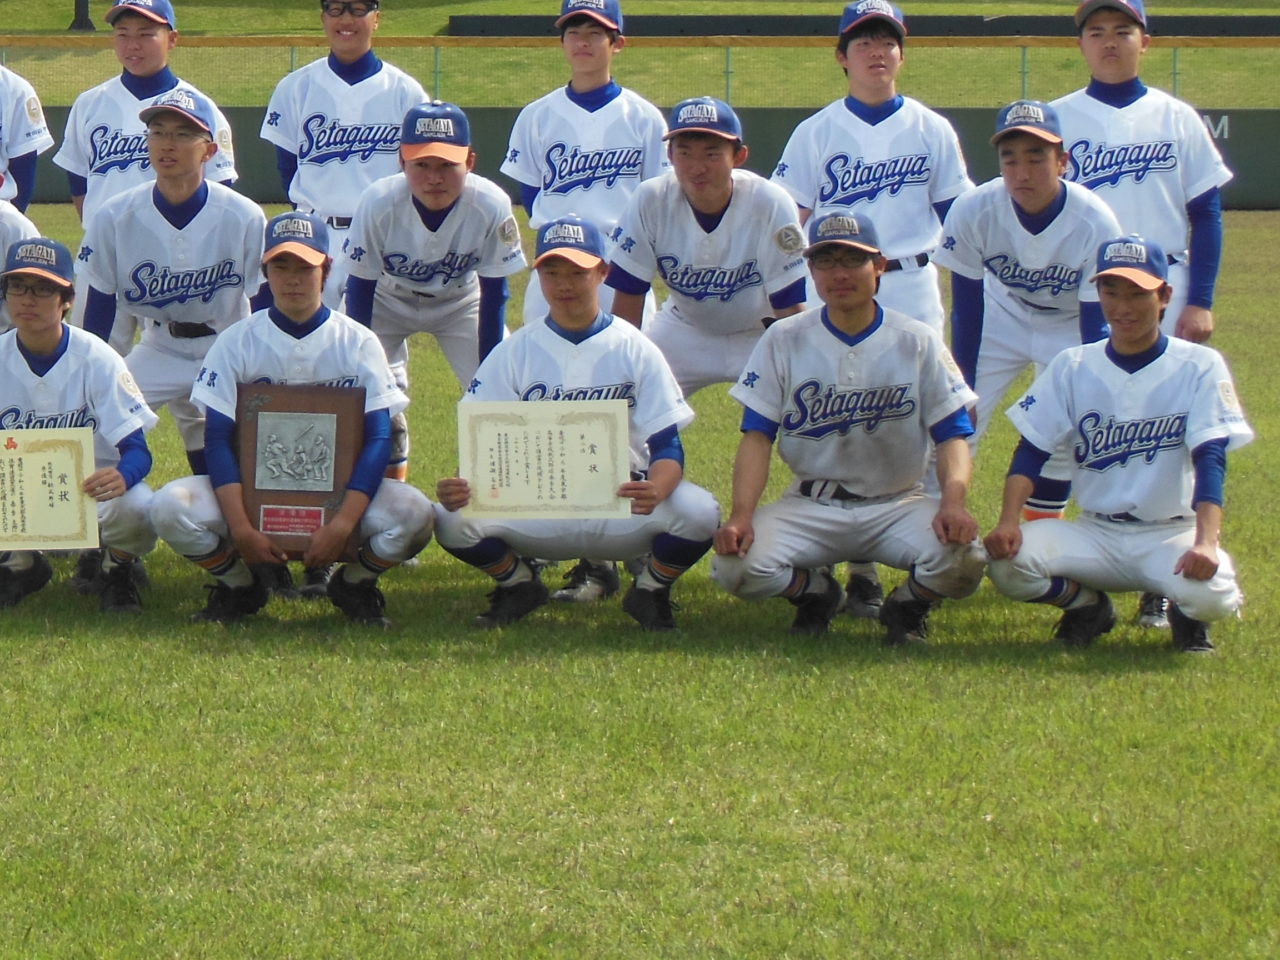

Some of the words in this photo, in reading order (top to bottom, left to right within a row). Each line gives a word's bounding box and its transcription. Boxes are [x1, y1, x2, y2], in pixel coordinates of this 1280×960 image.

[299, 112, 401, 167] Setagaya
[1068, 140, 1177, 192] Setagaya
[543, 142, 643, 196] Setagaya
[819, 152, 931, 208] Setagaya
[123, 259, 242, 308] Setagaya
[656, 254, 761, 302] Setagaya
[984, 253, 1082, 296] Setagaya
[782, 377, 915, 442] Setagaya
[1075, 409, 1188, 473] Setagaya
